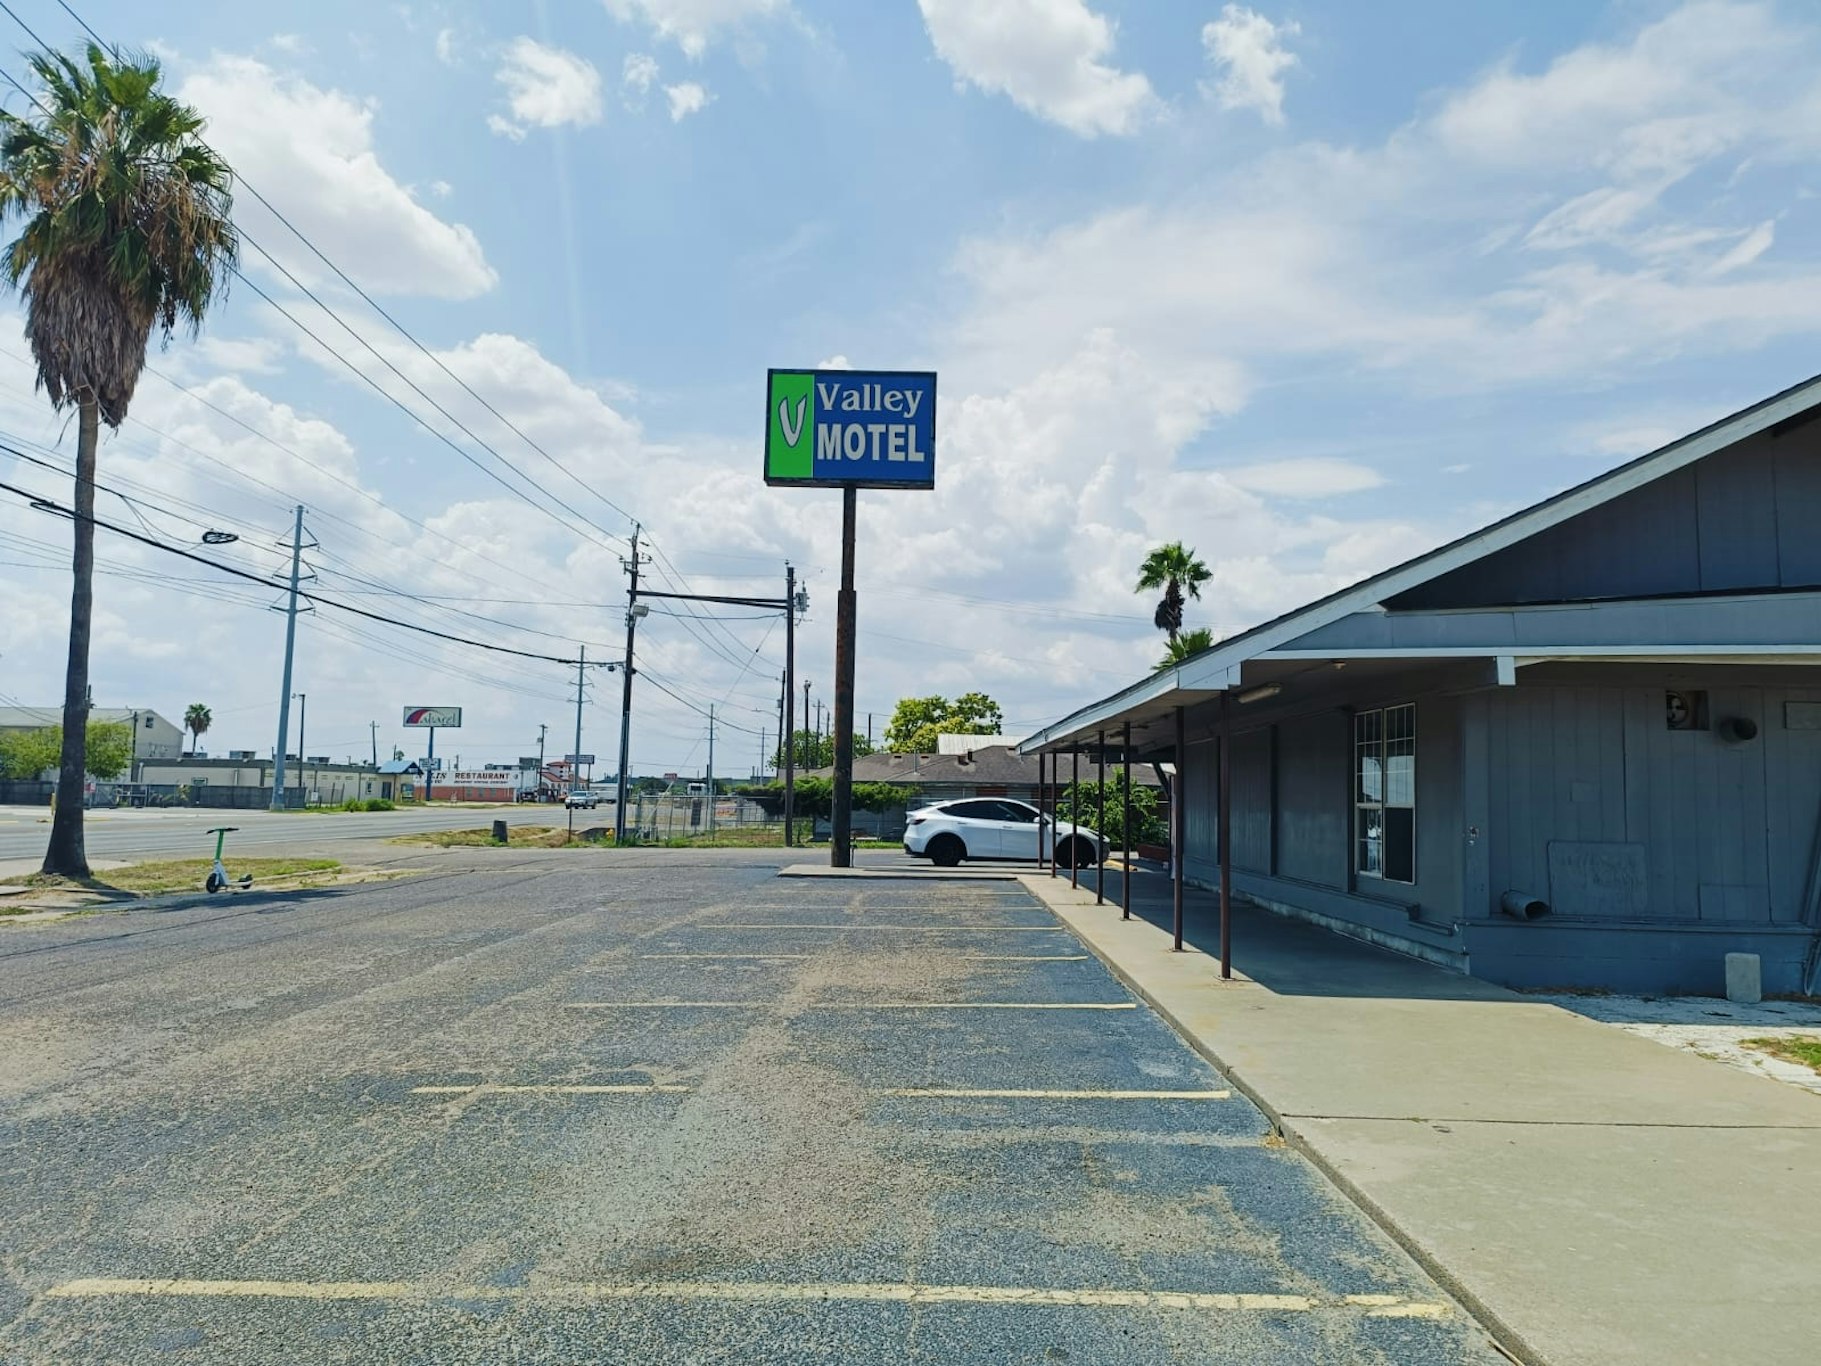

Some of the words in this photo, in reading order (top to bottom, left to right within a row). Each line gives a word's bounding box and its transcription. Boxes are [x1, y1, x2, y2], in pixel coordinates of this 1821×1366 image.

[817, 383, 924, 419] Valley
[778, 393, 808, 448] V
[817, 423, 925, 462] MOTEL
[455, 772, 510, 780] RESTAURANT
